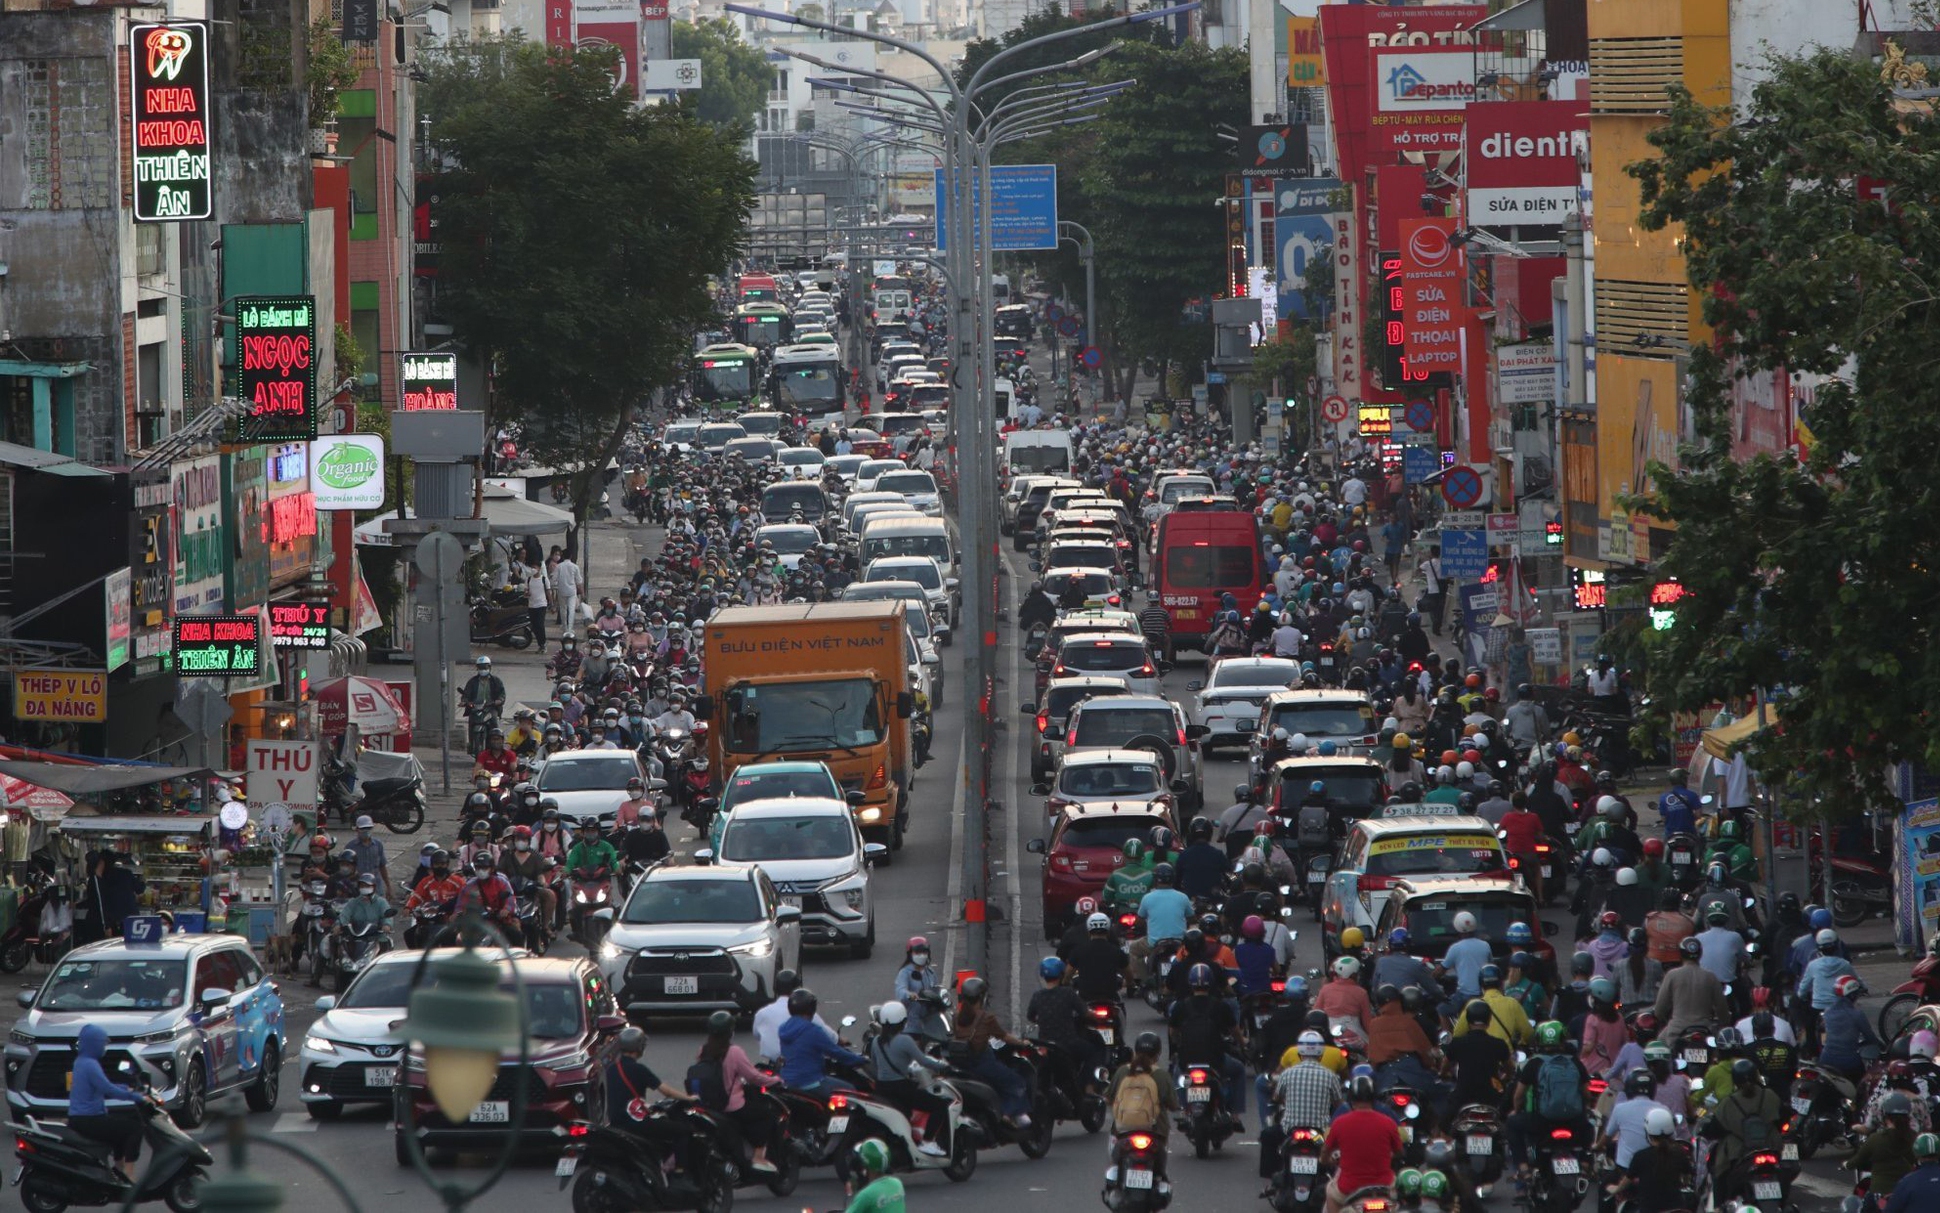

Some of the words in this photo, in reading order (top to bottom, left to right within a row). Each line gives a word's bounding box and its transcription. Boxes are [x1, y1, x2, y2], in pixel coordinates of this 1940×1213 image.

[147, 88, 196, 113] NHA
[139, 120, 204, 146] KHOA
[137, 150, 207, 181] THIÊN
[156, 185, 190, 215] ÂN
[1489, 196, 1518, 211] SỬA
[1524, 197, 1557, 214] ĐIỆN
[1406, 270, 1456, 279] FASTCARE.VN
[1416, 284, 1446, 302] SỬA
[1416, 307, 1450, 324] ĐIỆN
[244, 335, 309, 377] NGỌC
[1409, 352, 1457, 363] LAPTOP
[252, 381, 304, 416] ANH
[316, 458, 378, 478] Organic
[272, 604, 310, 623] THÚ
[313, 608, 327, 624] Y
[180, 623, 210, 640] NHA
[214, 622, 254, 640] KHOA
[721, 640, 756, 653] BƯU
[761, 636, 803, 653] ĐIỆN
[807, 635, 842, 650] VIỆT
[847, 637, 884, 648] NAM
[179, 645, 228, 669] THIÊN
[231, 645, 254, 669] ÂN
[21, 675, 61, 693] THÉP
[67, 680, 76, 694] V
[26, 701, 46, 715] ĐA
[52, 698, 96, 716] NĂNG
[254, 745, 311, 772] THÚ
[277, 779, 295, 801] Y
[1407, 838, 1446, 848] MPE
[1119, 883, 1147, 893] Grab
[132, 919, 151, 939] G7
[375, 1069, 390, 1077] 51K
[481, 1101, 497, 1111] 62A
